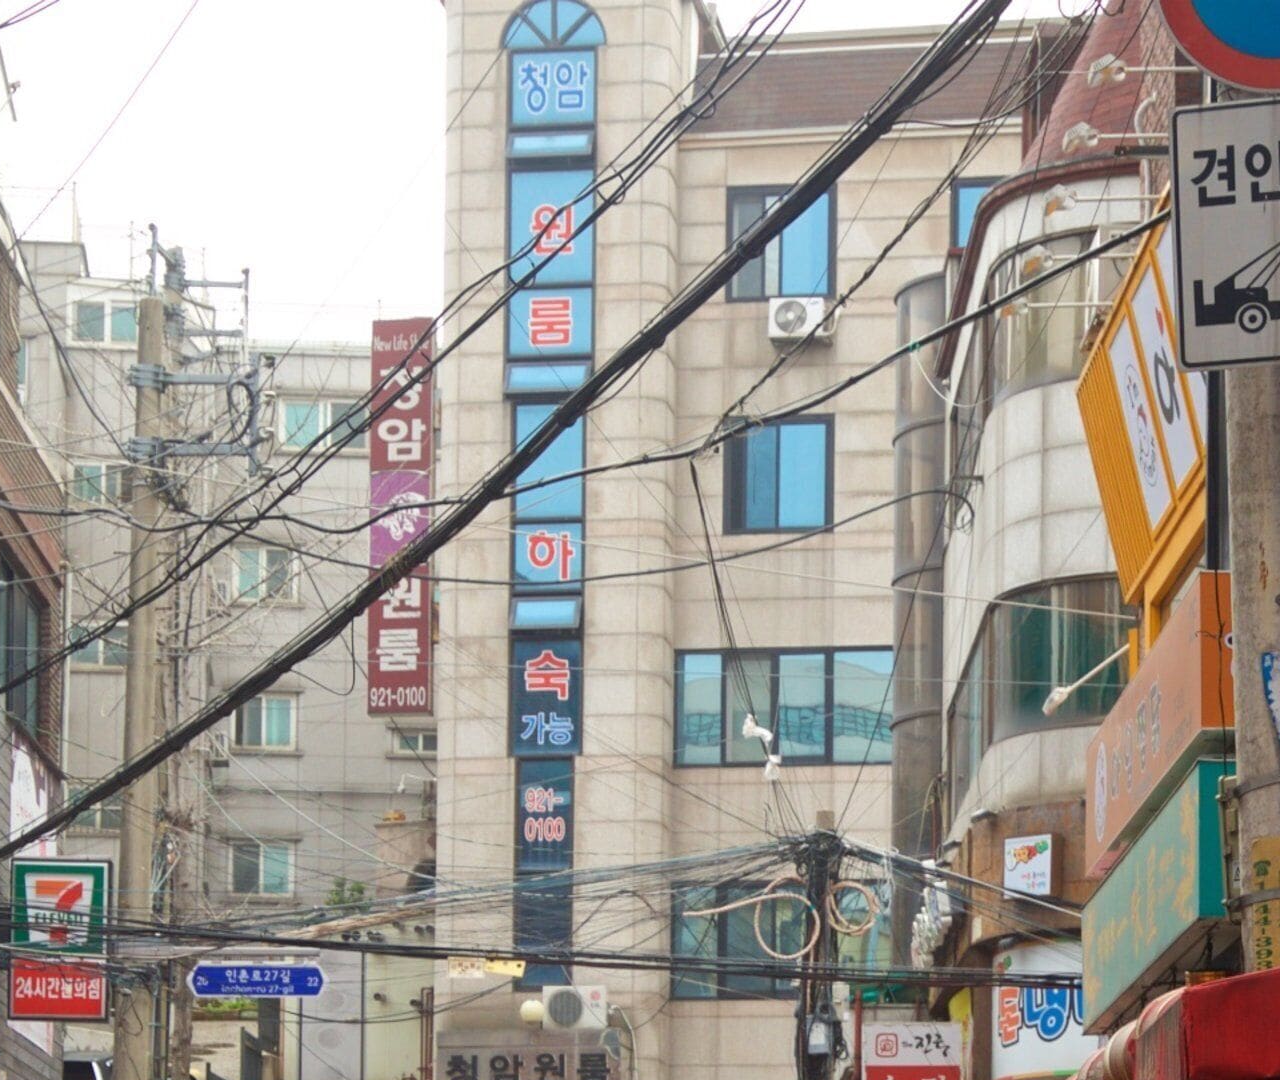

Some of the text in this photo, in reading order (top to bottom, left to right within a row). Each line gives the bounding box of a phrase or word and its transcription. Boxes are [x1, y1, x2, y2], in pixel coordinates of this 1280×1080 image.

[520, 62, 588, 114] 청암
[530, 204, 574, 346] 원룸
[370, 686, 426, 708] 921-0100
[521, 713, 574, 746] 가능
[524, 816, 566, 842] 0100
[224, 969, 291, 984] 인촌로27길
[999, 983, 1084, 1047] 돈냉
